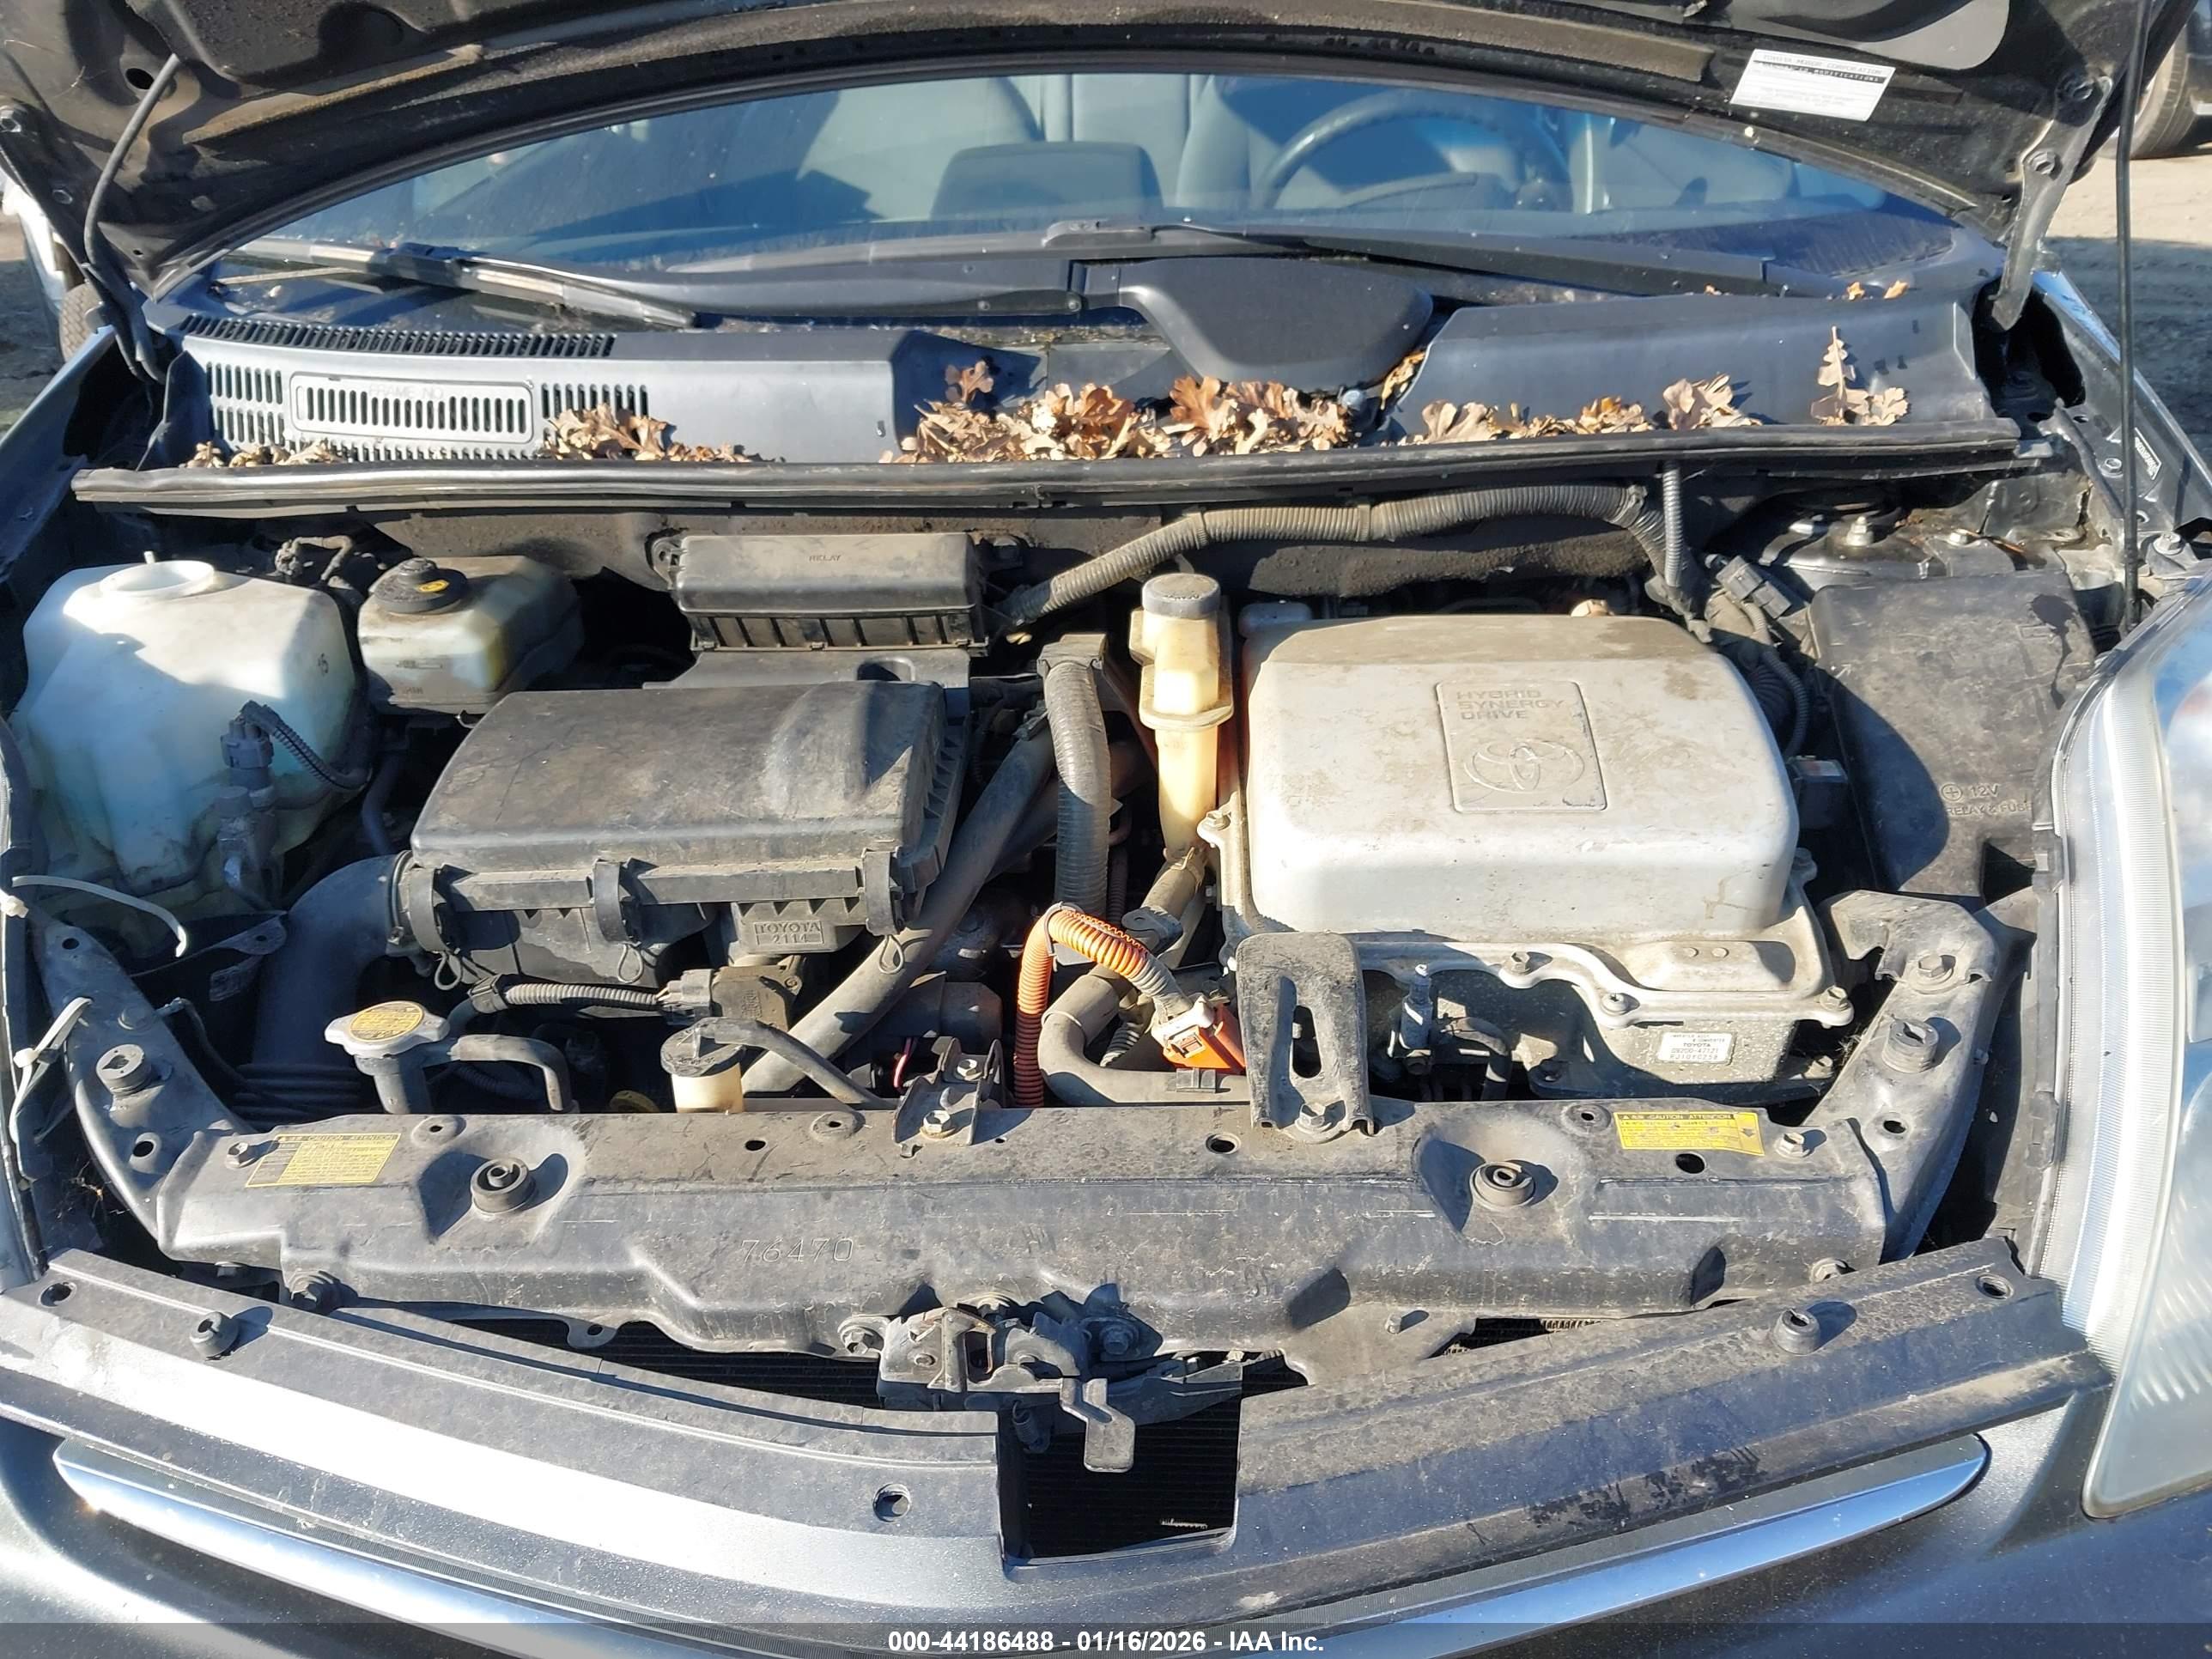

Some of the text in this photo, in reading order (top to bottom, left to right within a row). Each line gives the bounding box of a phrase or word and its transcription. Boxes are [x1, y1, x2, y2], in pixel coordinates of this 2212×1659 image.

[808, 554, 842, 562] RELAY
[1456, 690, 1542, 699] HYBRID
[1457, 700, 1565, 709] SYNERGY
[1461, 710, 1528, 720] DRIVE
[1970, 784, 2000, 798] 12V
[1947, 805, 1984, 817] RELAY
[758, 922, 821, 933] TOYOTA
[773, 933, 808, 944] 2114
[740, 1237, 854, 1263] 76470
